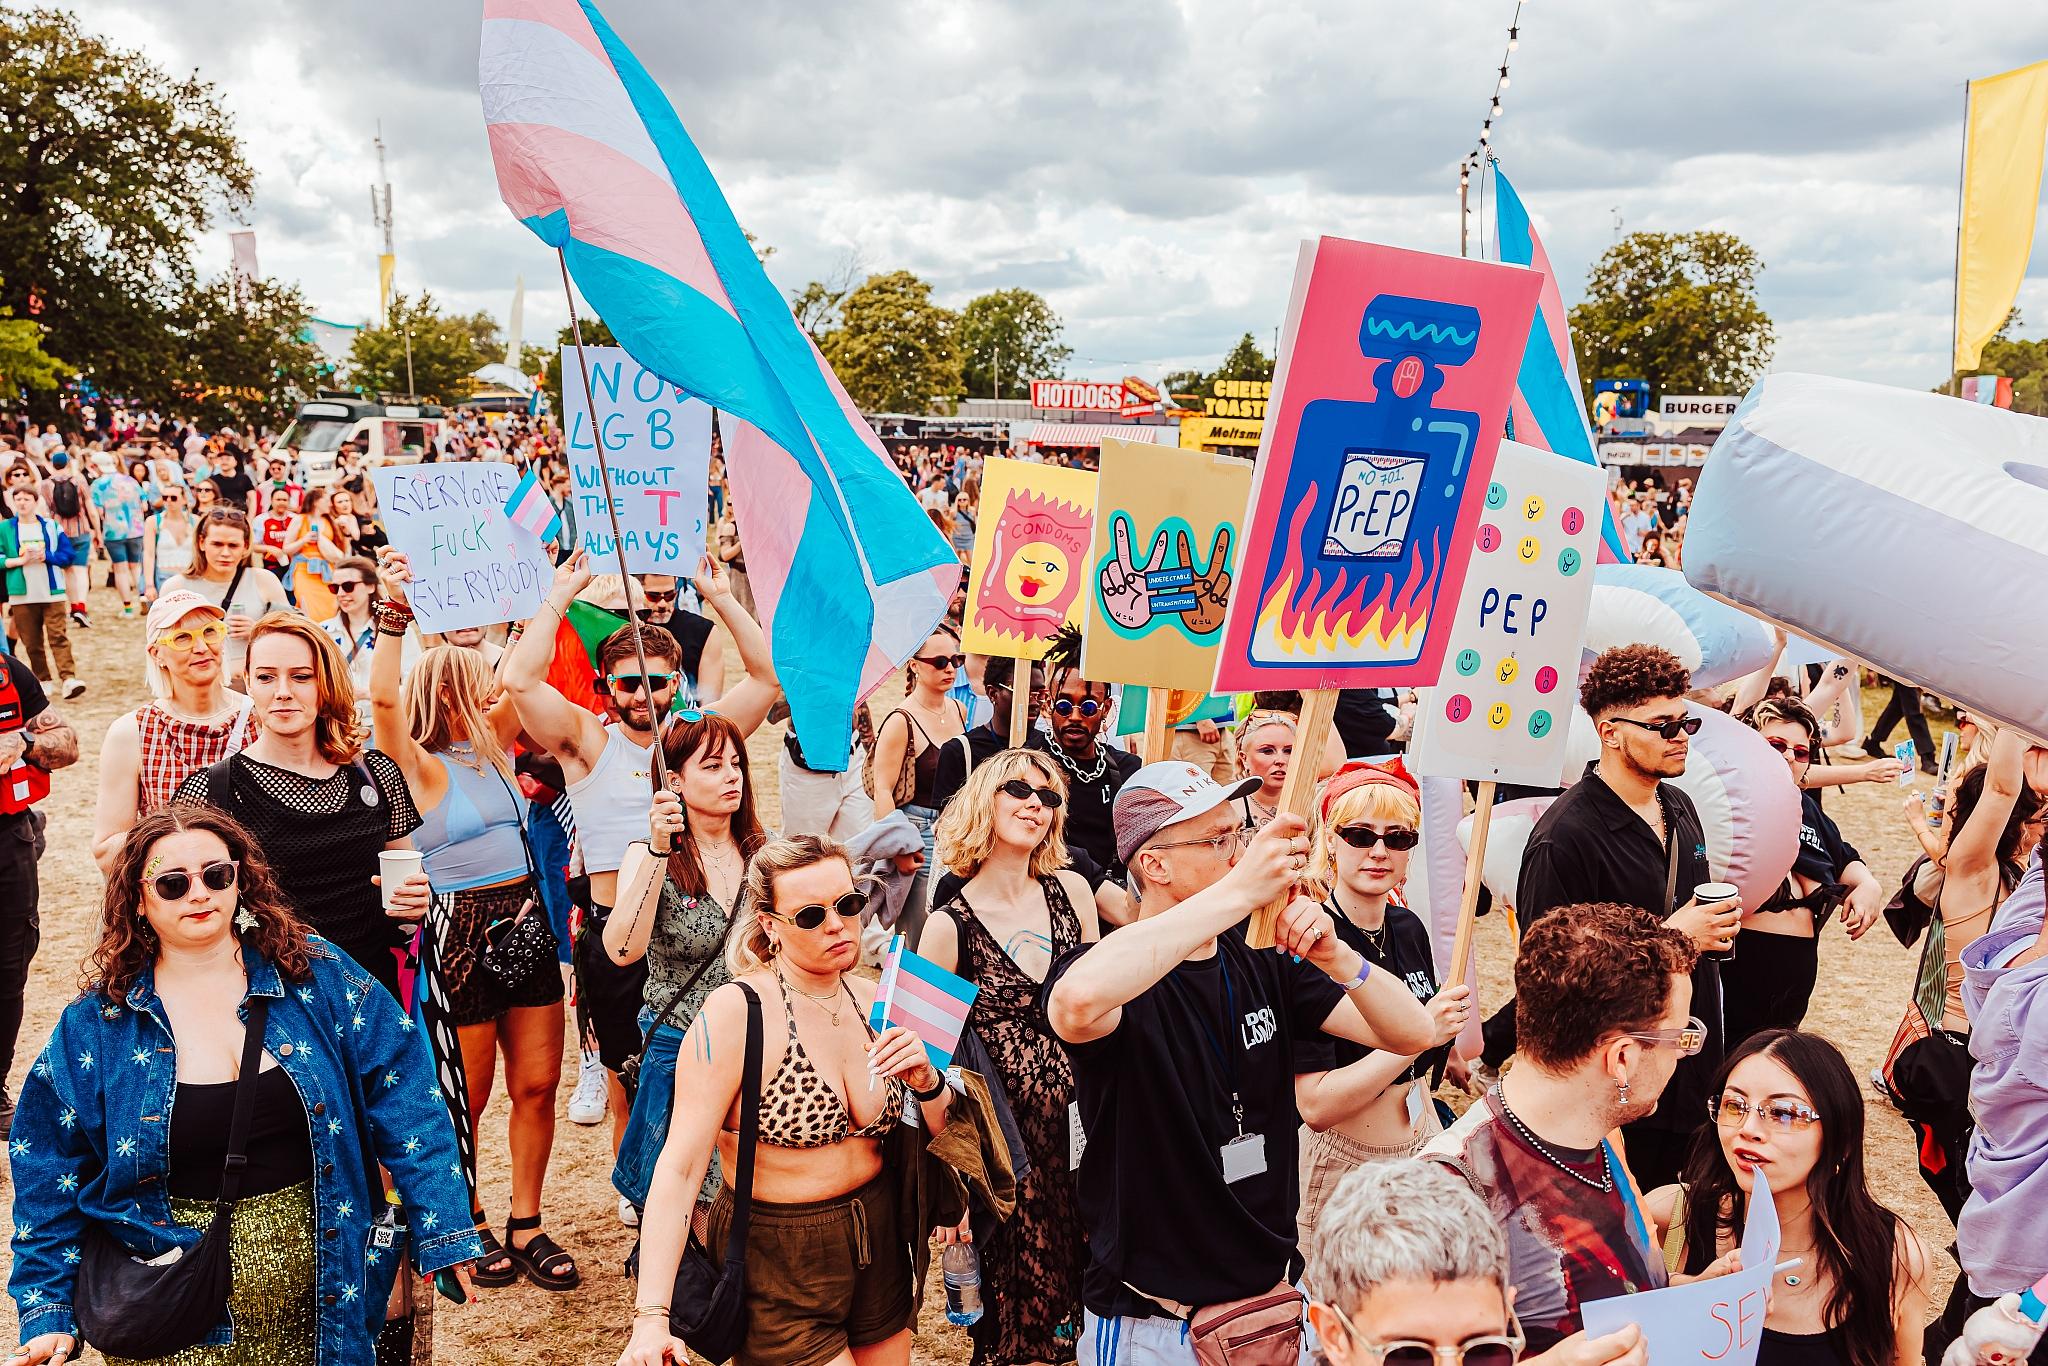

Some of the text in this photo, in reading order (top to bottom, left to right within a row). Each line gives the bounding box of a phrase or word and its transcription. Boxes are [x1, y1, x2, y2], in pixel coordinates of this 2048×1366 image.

[1037, 383, 1122, 409] HOTDOGS
[1665, 402, 1736, 414] BURGER
[580, 490, 680, 526] THE T
[1333, 484, 1410, 537] PrEP
[430, 515, 491, 566] FUCK
[584, 530, 679, 562] ALWAYS
[1011, 523, 1081, 553] CONDOMS
[413, 558, 543, 617] EVERYBODY
[1148, 573, 1191, 584] UNDETECTABLE
[1151, 598, 1195, 608] UNTRANSMITTABLE
[1480, 587, 1547, 637] PEP
